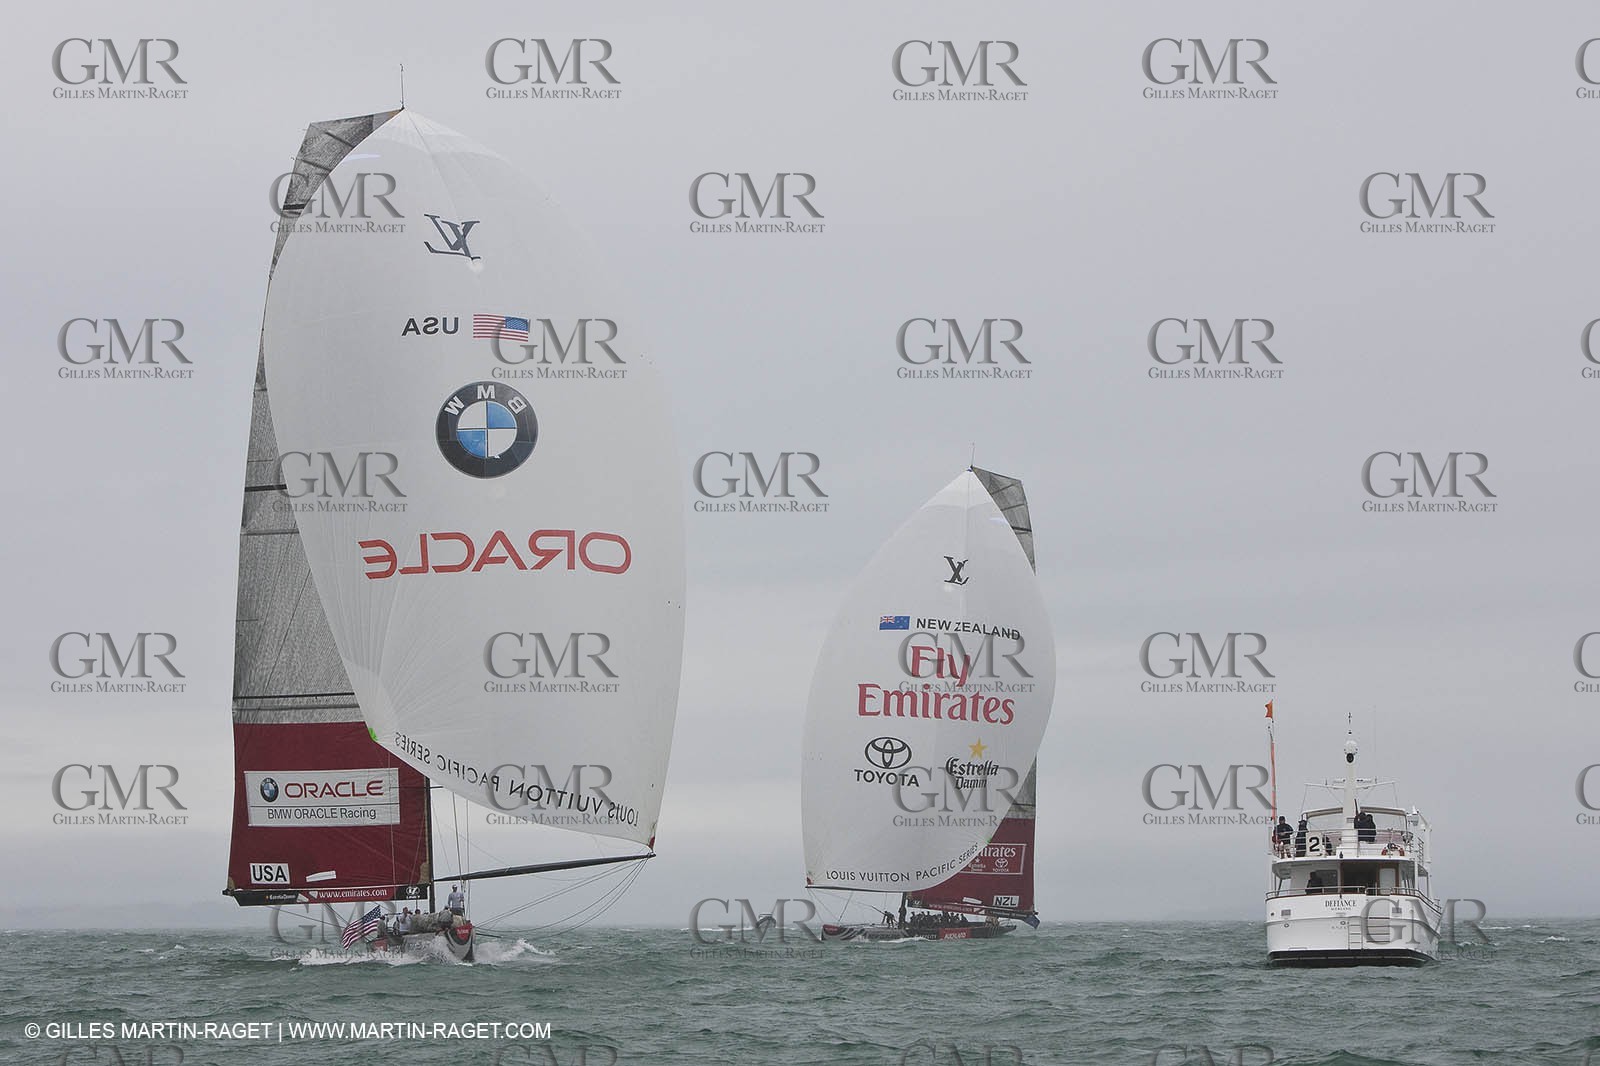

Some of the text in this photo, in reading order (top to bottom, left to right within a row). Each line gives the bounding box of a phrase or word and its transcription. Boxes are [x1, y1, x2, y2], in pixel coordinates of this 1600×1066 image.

[916, 618, 1021, 641] NEW ZEALAND
[911, 645, 971, 687] Fly
[857, 682, 1016, 725] Emirates
[945, 756, 999, 777] Estrella
[854, 769, 920, 788] TOYOTA
[955, 776, 988, 790] Damm
[284, 780, 384, 799] ORACLE
[268, 807, 377, 820] BMW ORACLE Racing
[1309, 836, 1320, 852] 2
[252, 865, 287, 882] USA
[826, 870, 856, 881] LOUIS
[859, 872, 910, 883] VUITTON
[916, 859, 956, 881] PACIFIC
[320, 888, 388, 899] www.emirates.com
[995, 896, 1017, 906] NZL
